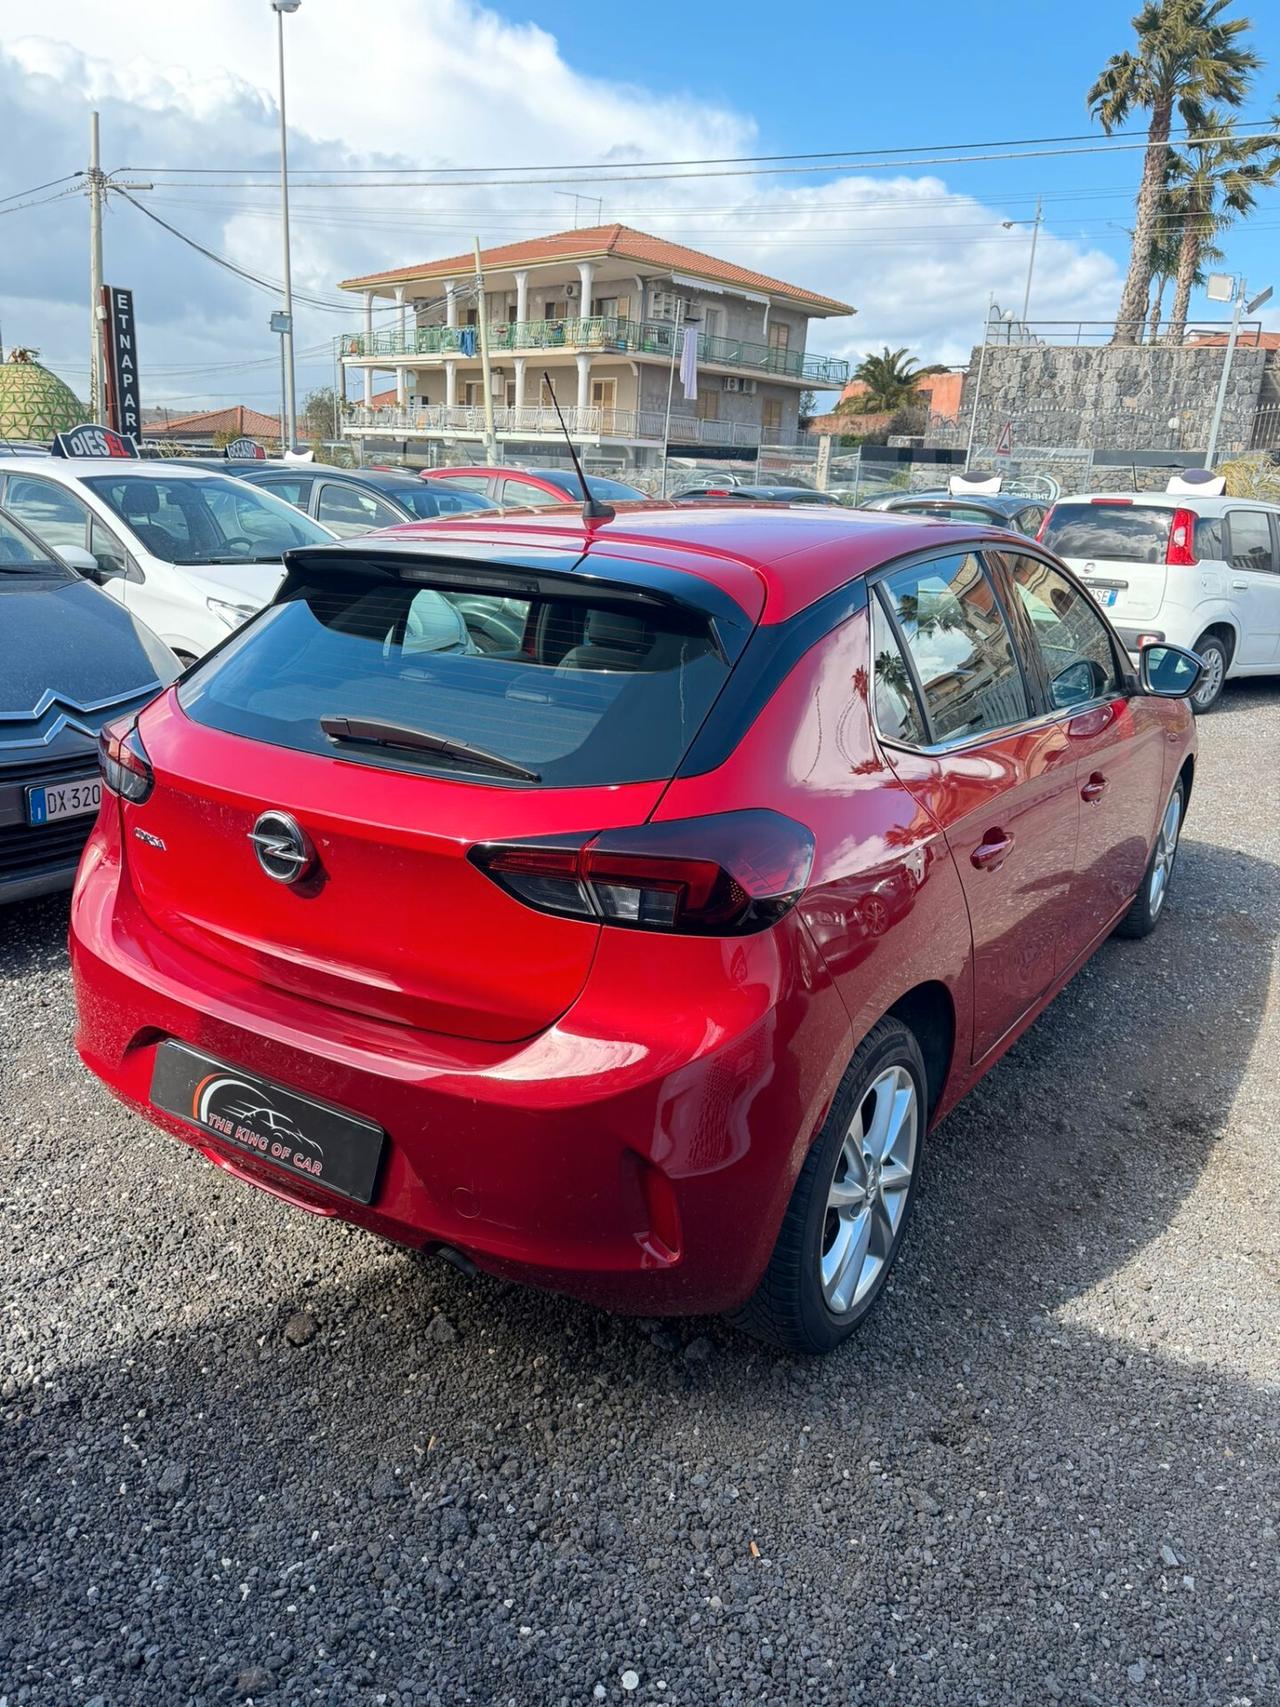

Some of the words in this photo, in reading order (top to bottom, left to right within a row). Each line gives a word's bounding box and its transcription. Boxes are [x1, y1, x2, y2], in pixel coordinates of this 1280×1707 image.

[70, 430, 131, 457] DIESEL
[47, 790, 67, 814] DX
[71, 784, 101, 809] 320
[37, 807, 42, 820] I
[208, 1112, 234, 1135] THE
[235, 1125, 270, 1151] KING
[270, 1142, 292, 1160] OF
[293, 1152, 323, 1176] CAR
